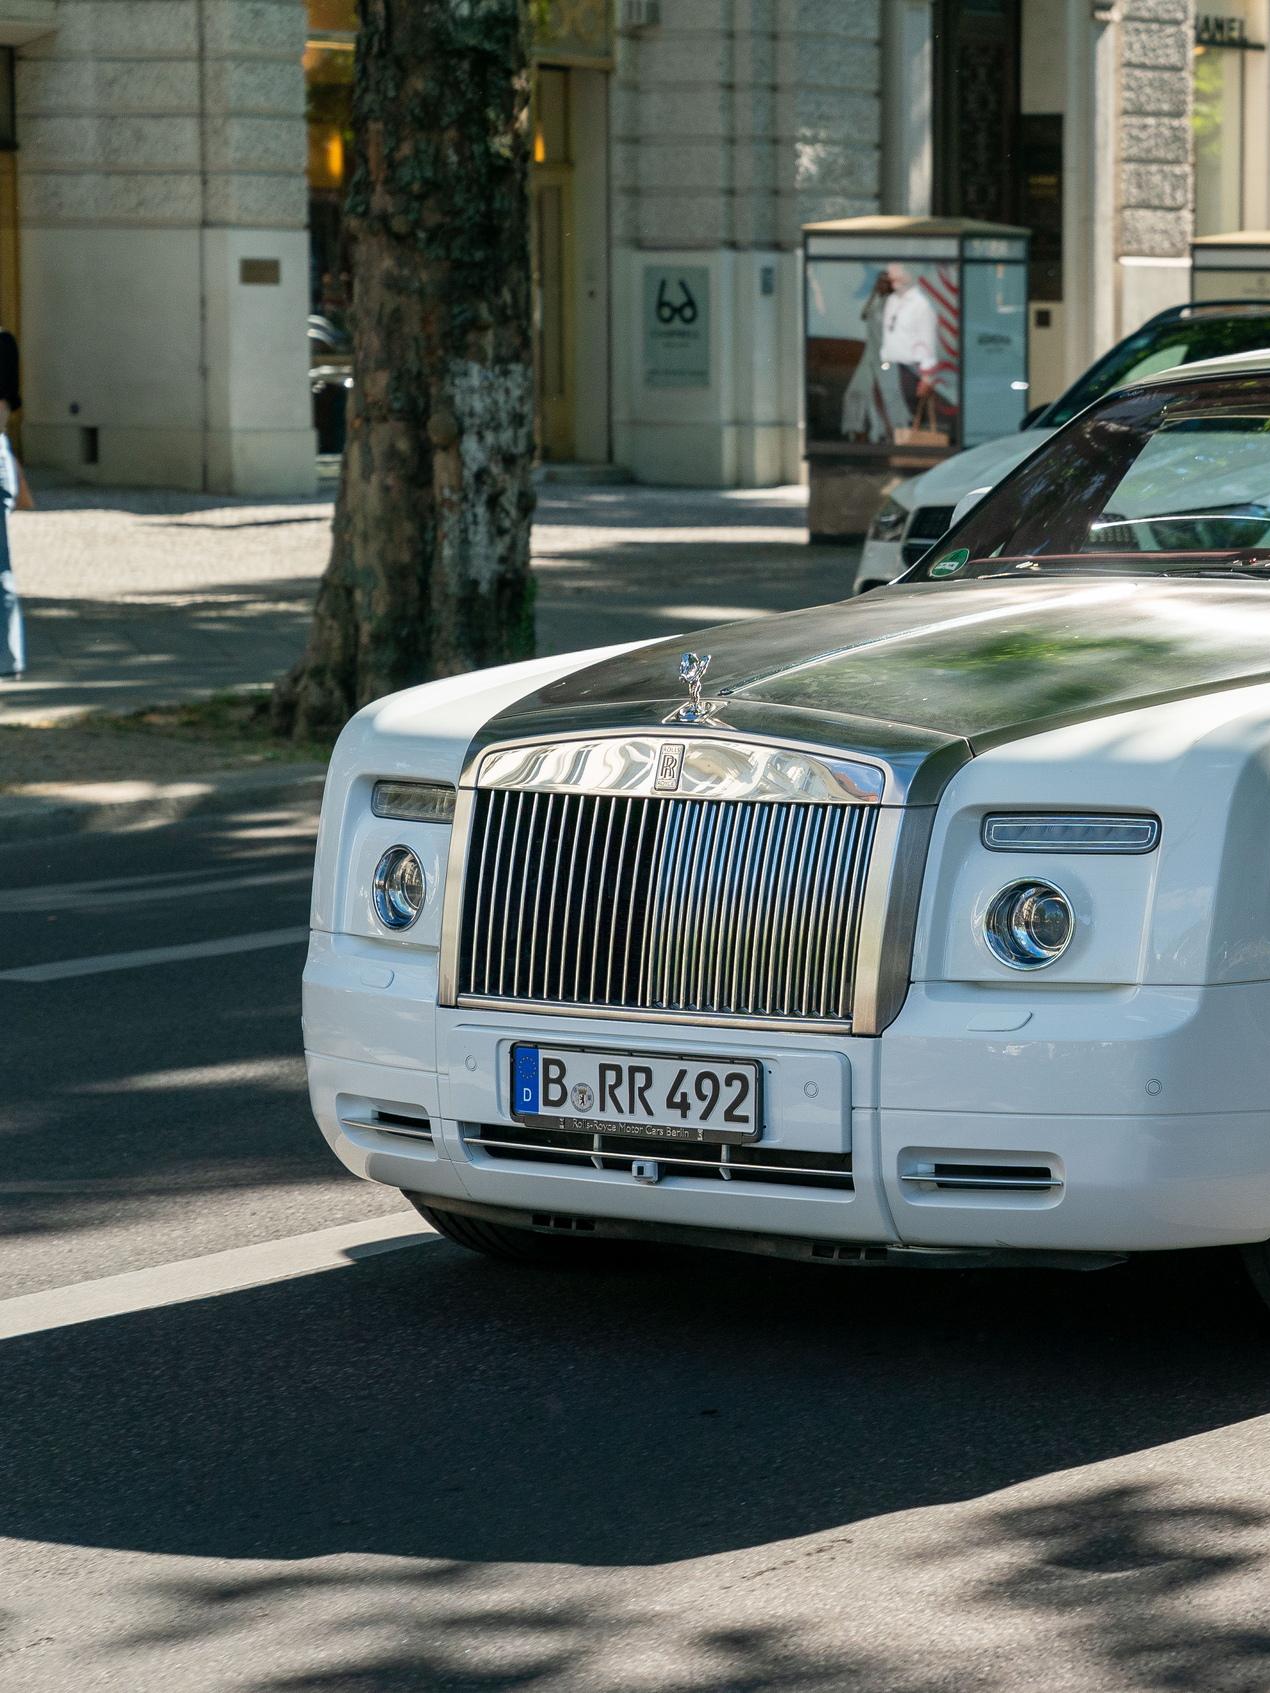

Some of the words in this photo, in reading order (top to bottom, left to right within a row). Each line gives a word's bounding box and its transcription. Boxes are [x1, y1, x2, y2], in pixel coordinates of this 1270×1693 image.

[523, 1088, 532, 1102] D
[542, 1057, 568, 1107] B
[599, 1063, 655, 1117] RR
[666, 1068, 749, 1124] 492
[572, 1118, 617, 1132] Rolls-Royce
[619, 1122, 644, 1134] Motor
[645, 1125, 664, 1136] Cars
[666, 1127, 690, 1138] Berlin
